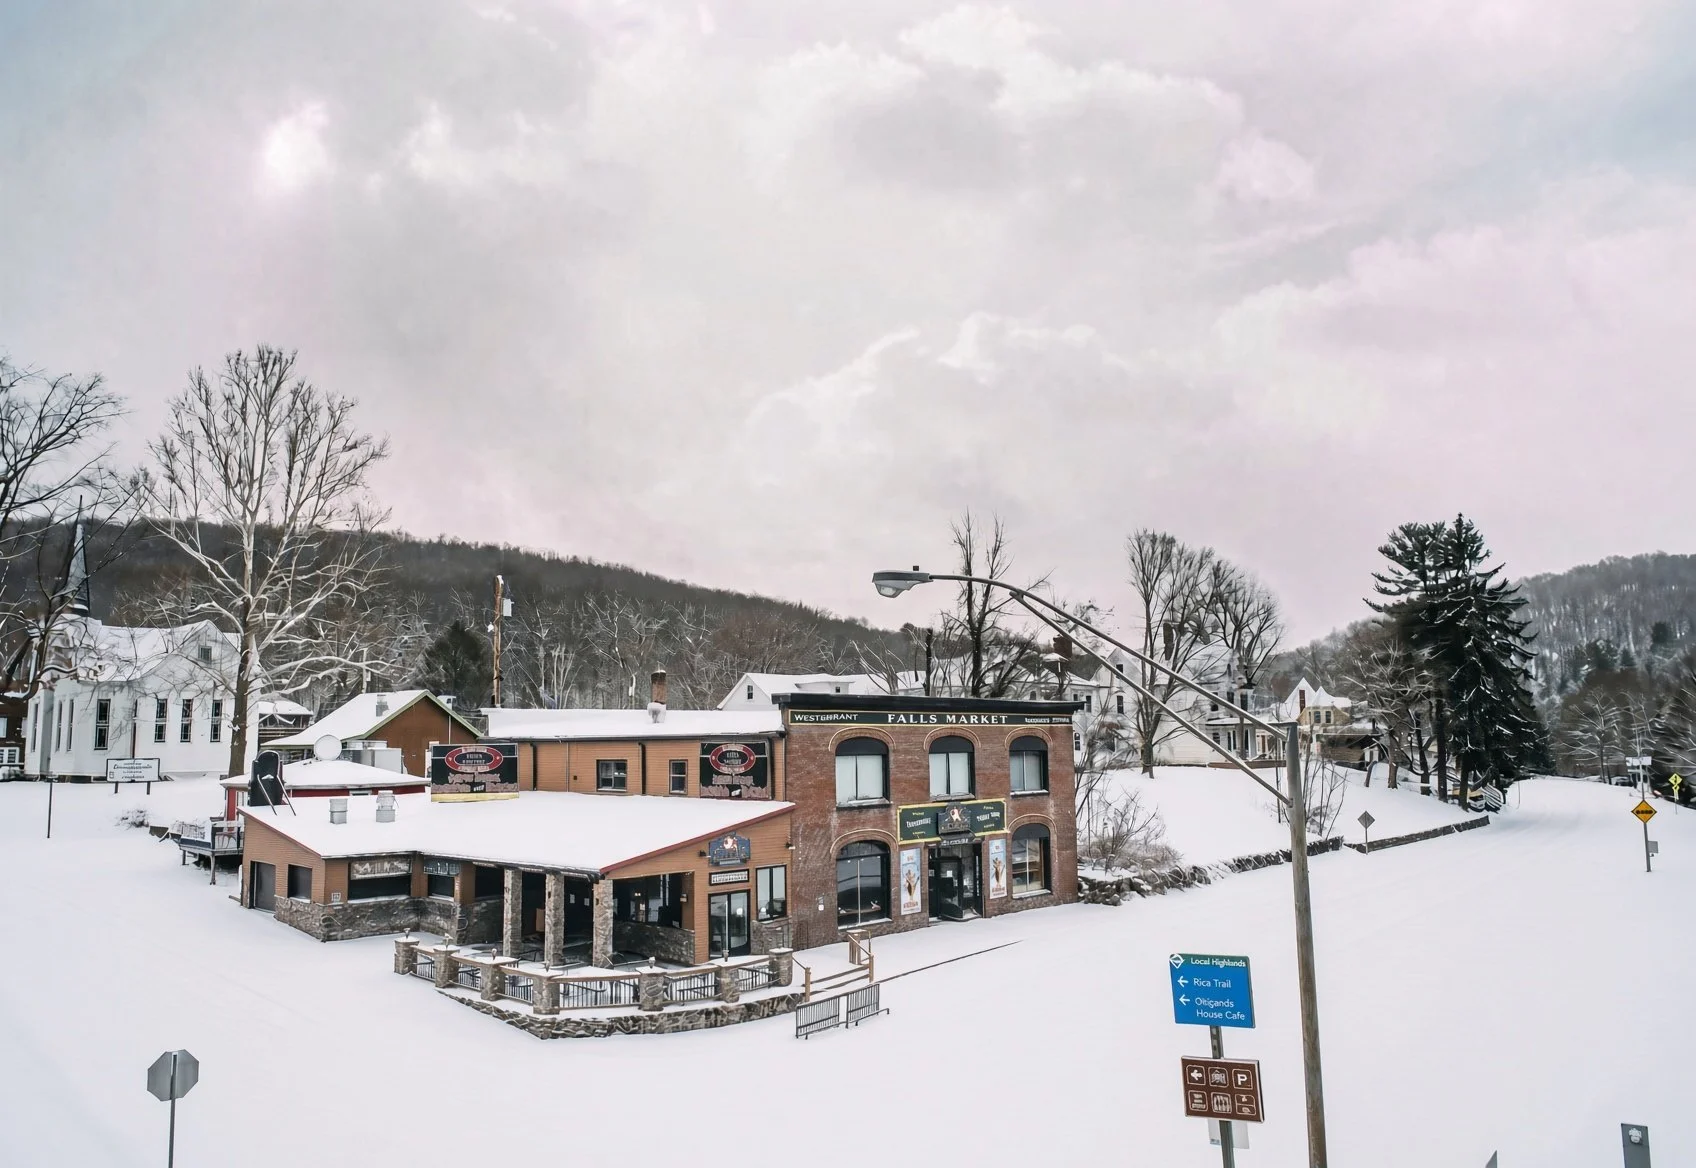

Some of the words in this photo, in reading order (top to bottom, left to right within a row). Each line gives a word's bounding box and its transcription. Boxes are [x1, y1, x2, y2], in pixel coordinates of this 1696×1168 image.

[887, 713, 938, 723] FALLS
[946, 714, 1008, 724] MARKET
[1190, 957, 1210, 965] Local
[1211, 958, 1246, 968] Highlands
[1193, 977, 1211, 988] Rica
[1213, 978, 1232, 989] Trail
[1196, 1009, 1223, 1019] House
[1225, 1010, 1246, 1021] Cafe
[1237, 1073, 1248, 1086] P
